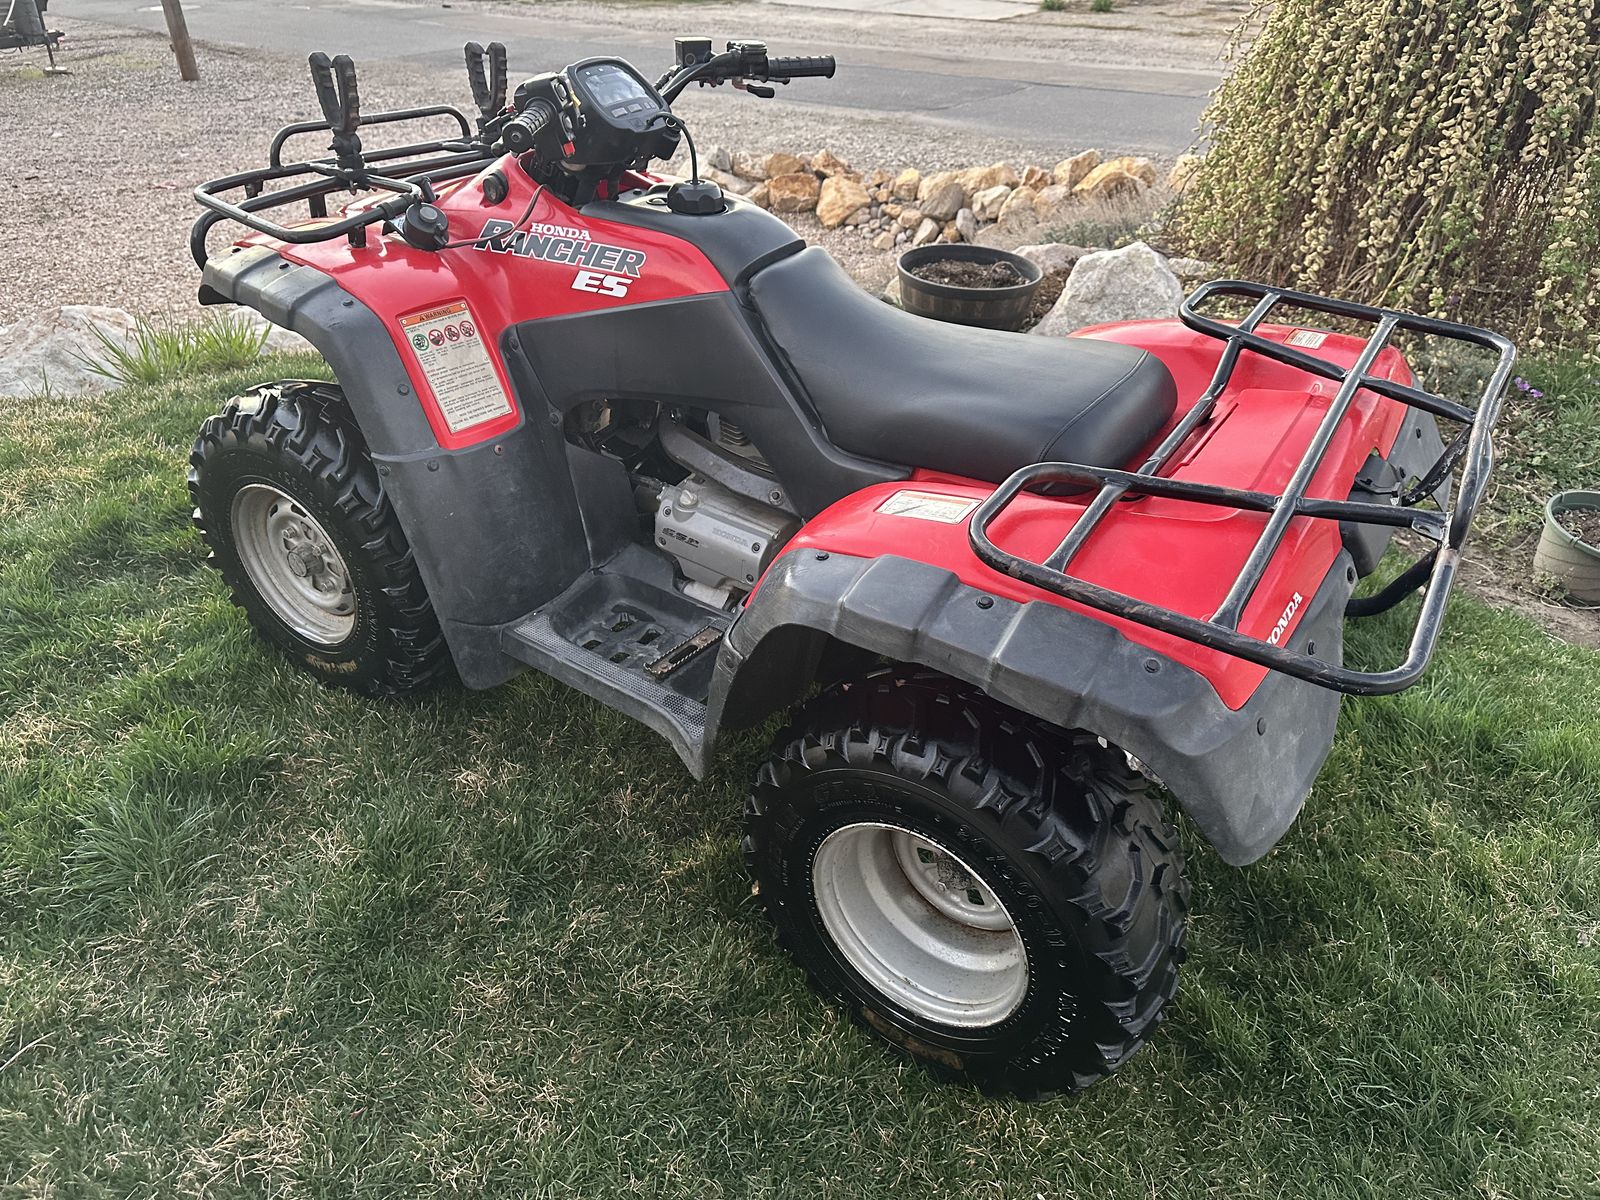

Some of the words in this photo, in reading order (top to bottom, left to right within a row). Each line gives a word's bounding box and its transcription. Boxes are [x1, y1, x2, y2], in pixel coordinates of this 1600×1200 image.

[530, 222, 592, 240] HONDA
[473, 218, 646, 278] RANCHER
[571, 270, 634, 298] ES
[425, 308, 451, 319] WARNING
